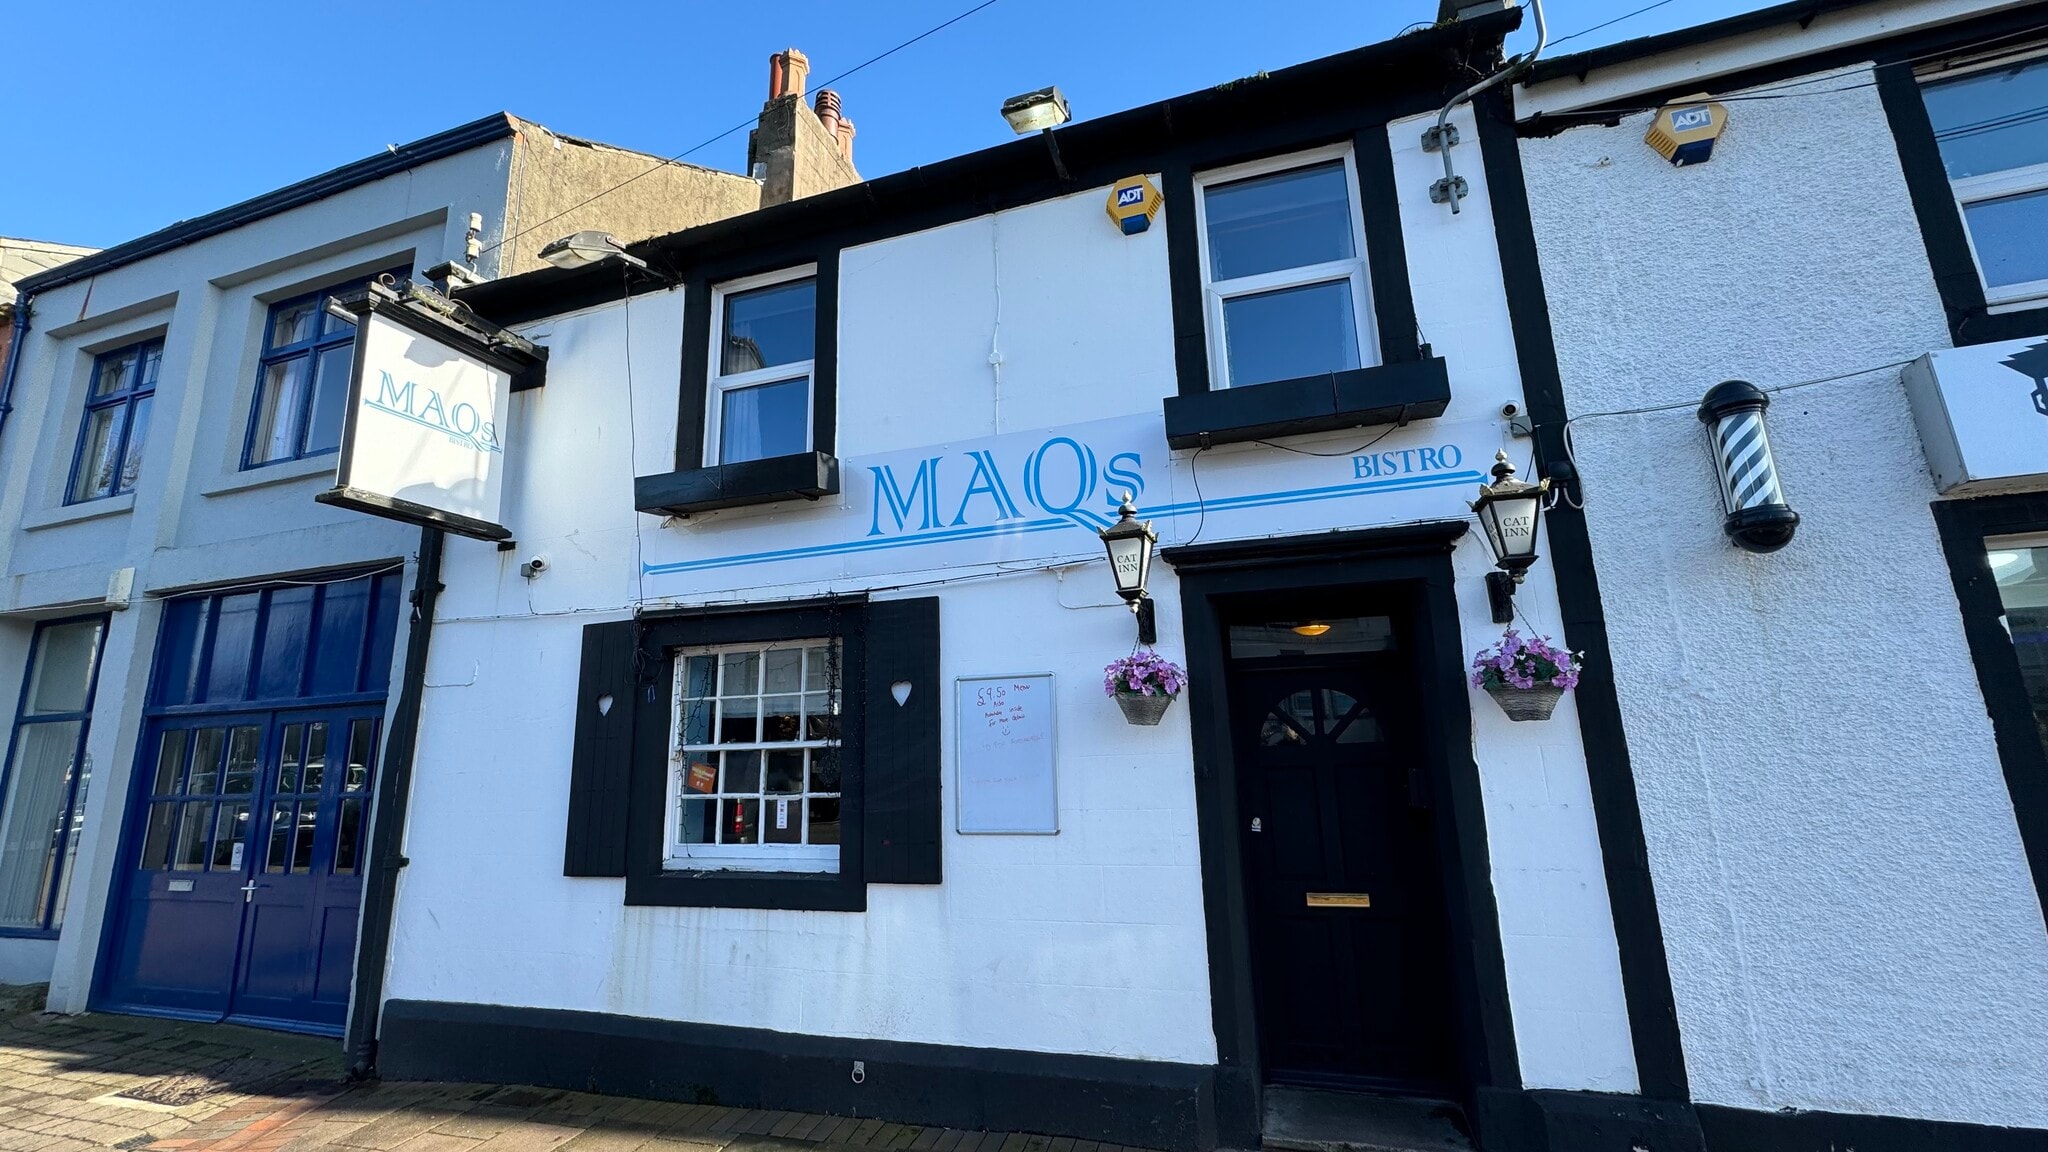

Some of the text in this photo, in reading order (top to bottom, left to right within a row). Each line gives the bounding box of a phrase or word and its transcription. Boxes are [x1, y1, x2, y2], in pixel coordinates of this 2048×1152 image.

[1674, 109, 1710, 129] ADT
[1118, 187, 1144, 205] ADT
[448, 436, 474, 450] BISTRO
[866, 436, 1462, 537] MAQs BISTRO
[1503, 516, 1530, 527] CAT
[1504, 527, 1530, 538] INN
[1117, 553, 1137, 564] CAT
[1118, 563, 1138, 573] INN
